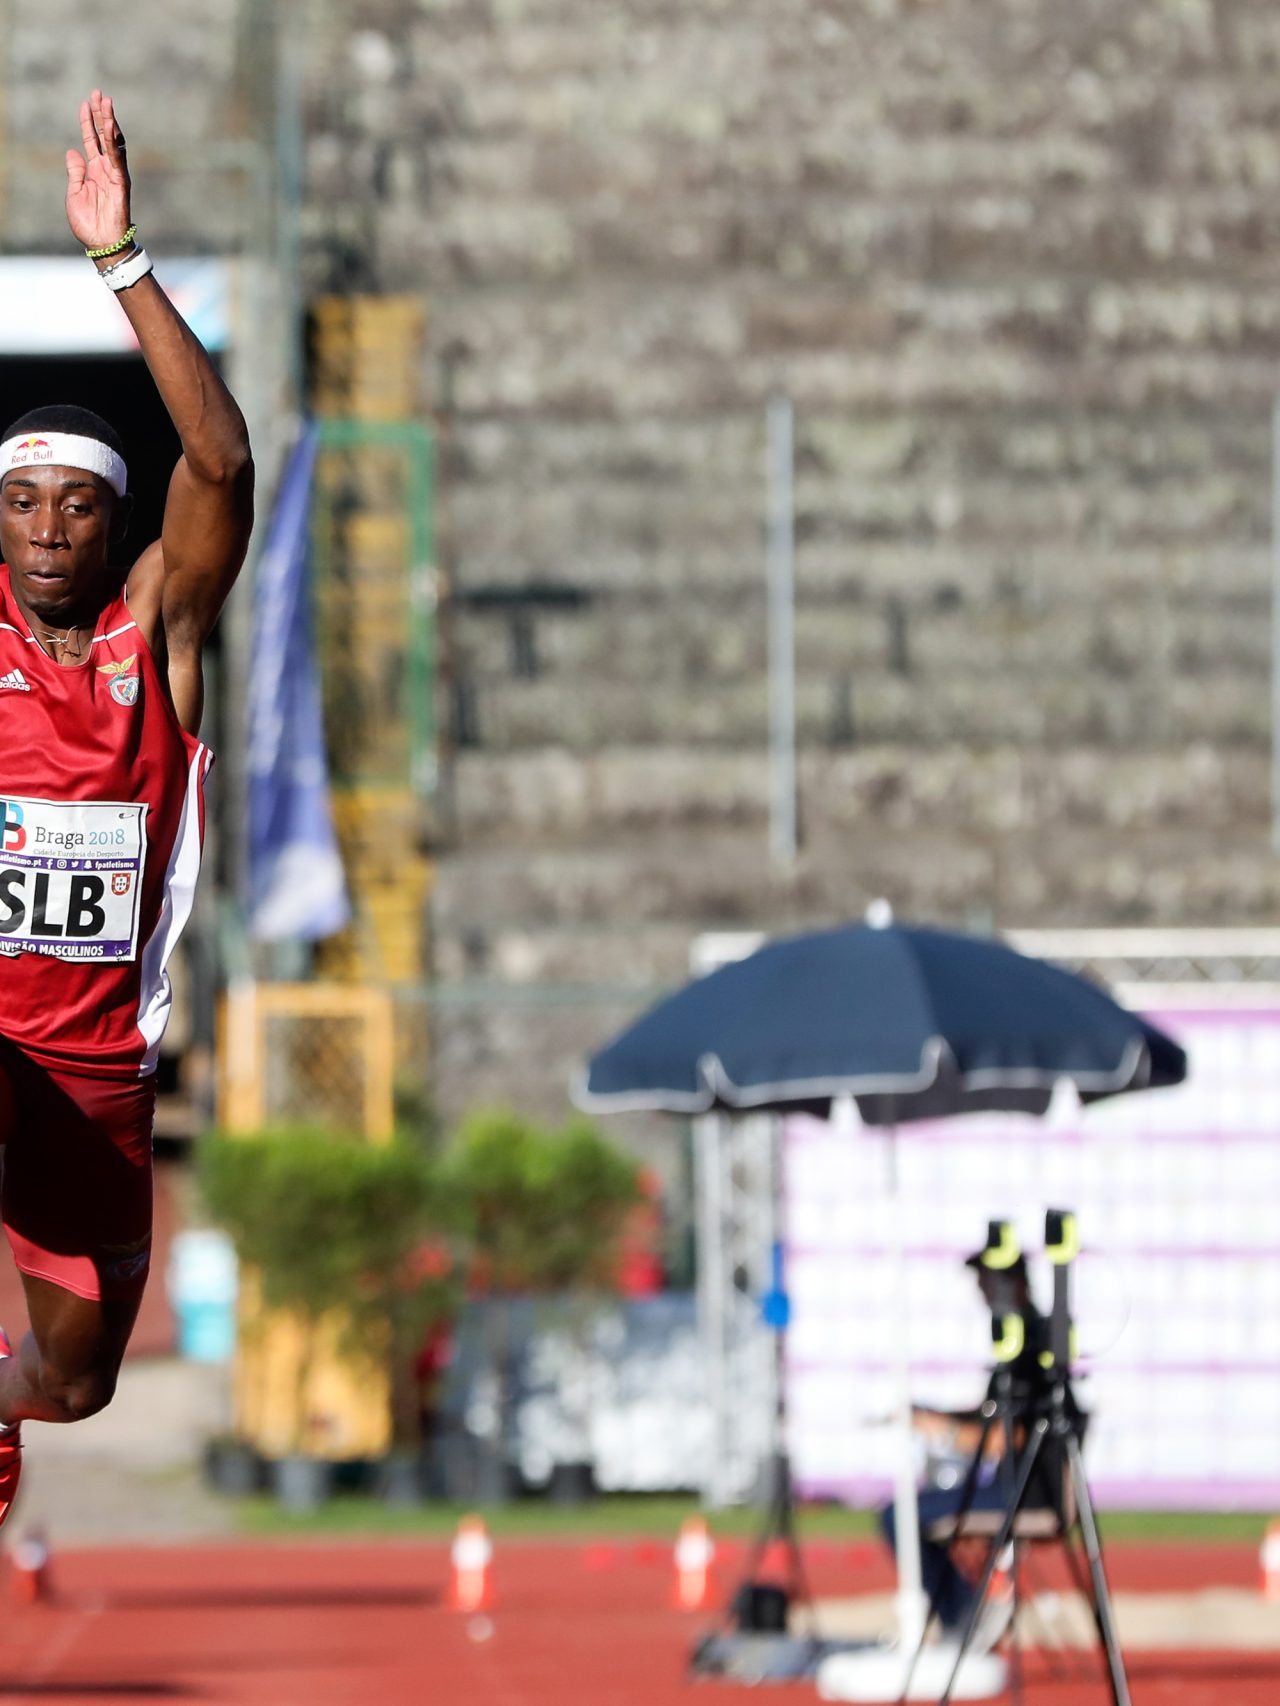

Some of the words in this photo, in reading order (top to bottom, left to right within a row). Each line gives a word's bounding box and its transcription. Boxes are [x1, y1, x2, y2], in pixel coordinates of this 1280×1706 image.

[11, 453, 28, 464] Red
[33, 450, 53, 460] Bull
[35, 827, 84, 849] Braga
[88, 829, 125, 845] 2018
[33, 849, 56, 857] Cidade
[97, 850, 124, 859] Desporto
[95, 860, 135, 869] fpatletismo
[39, 943, 104, 957] MASCULINOS
